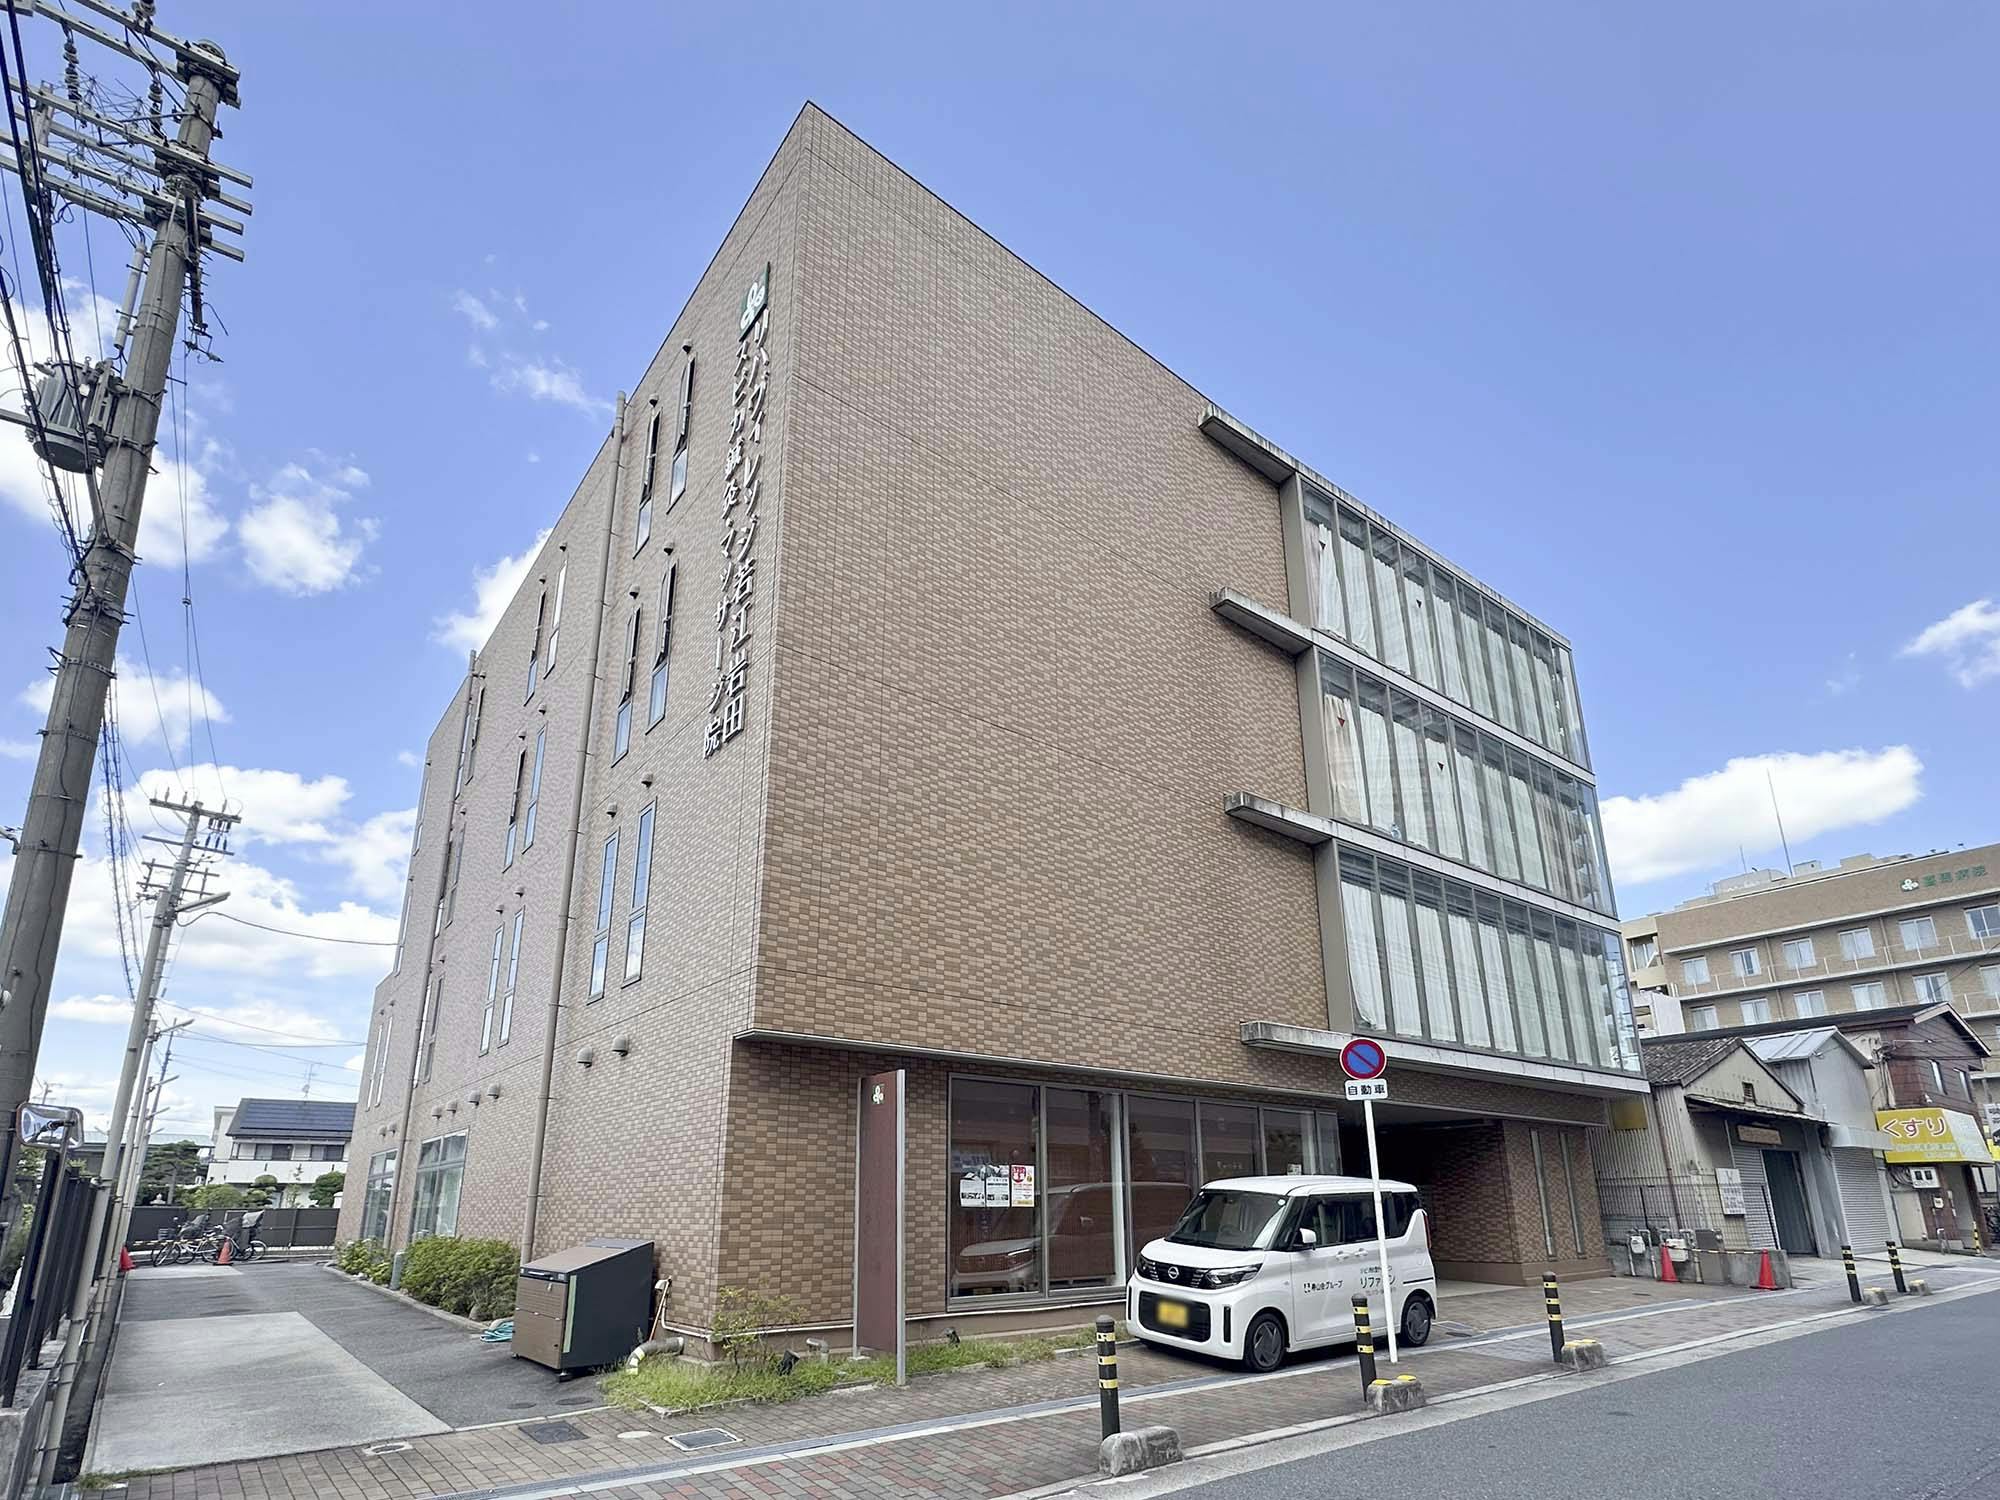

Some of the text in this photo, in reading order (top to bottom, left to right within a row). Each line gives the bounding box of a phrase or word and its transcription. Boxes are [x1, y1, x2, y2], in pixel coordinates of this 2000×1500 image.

[722, 308, 770, 744] リハヴィレッジ若江岩田
[703, 339, 750, 760] スピカ鍼灸・マッサージ院
[1347, 1084, 1386, 1096] 自動車
[1882, 1117, 1947, 1139] くすり
[1360, 1274, 1396, 1289] リファン
